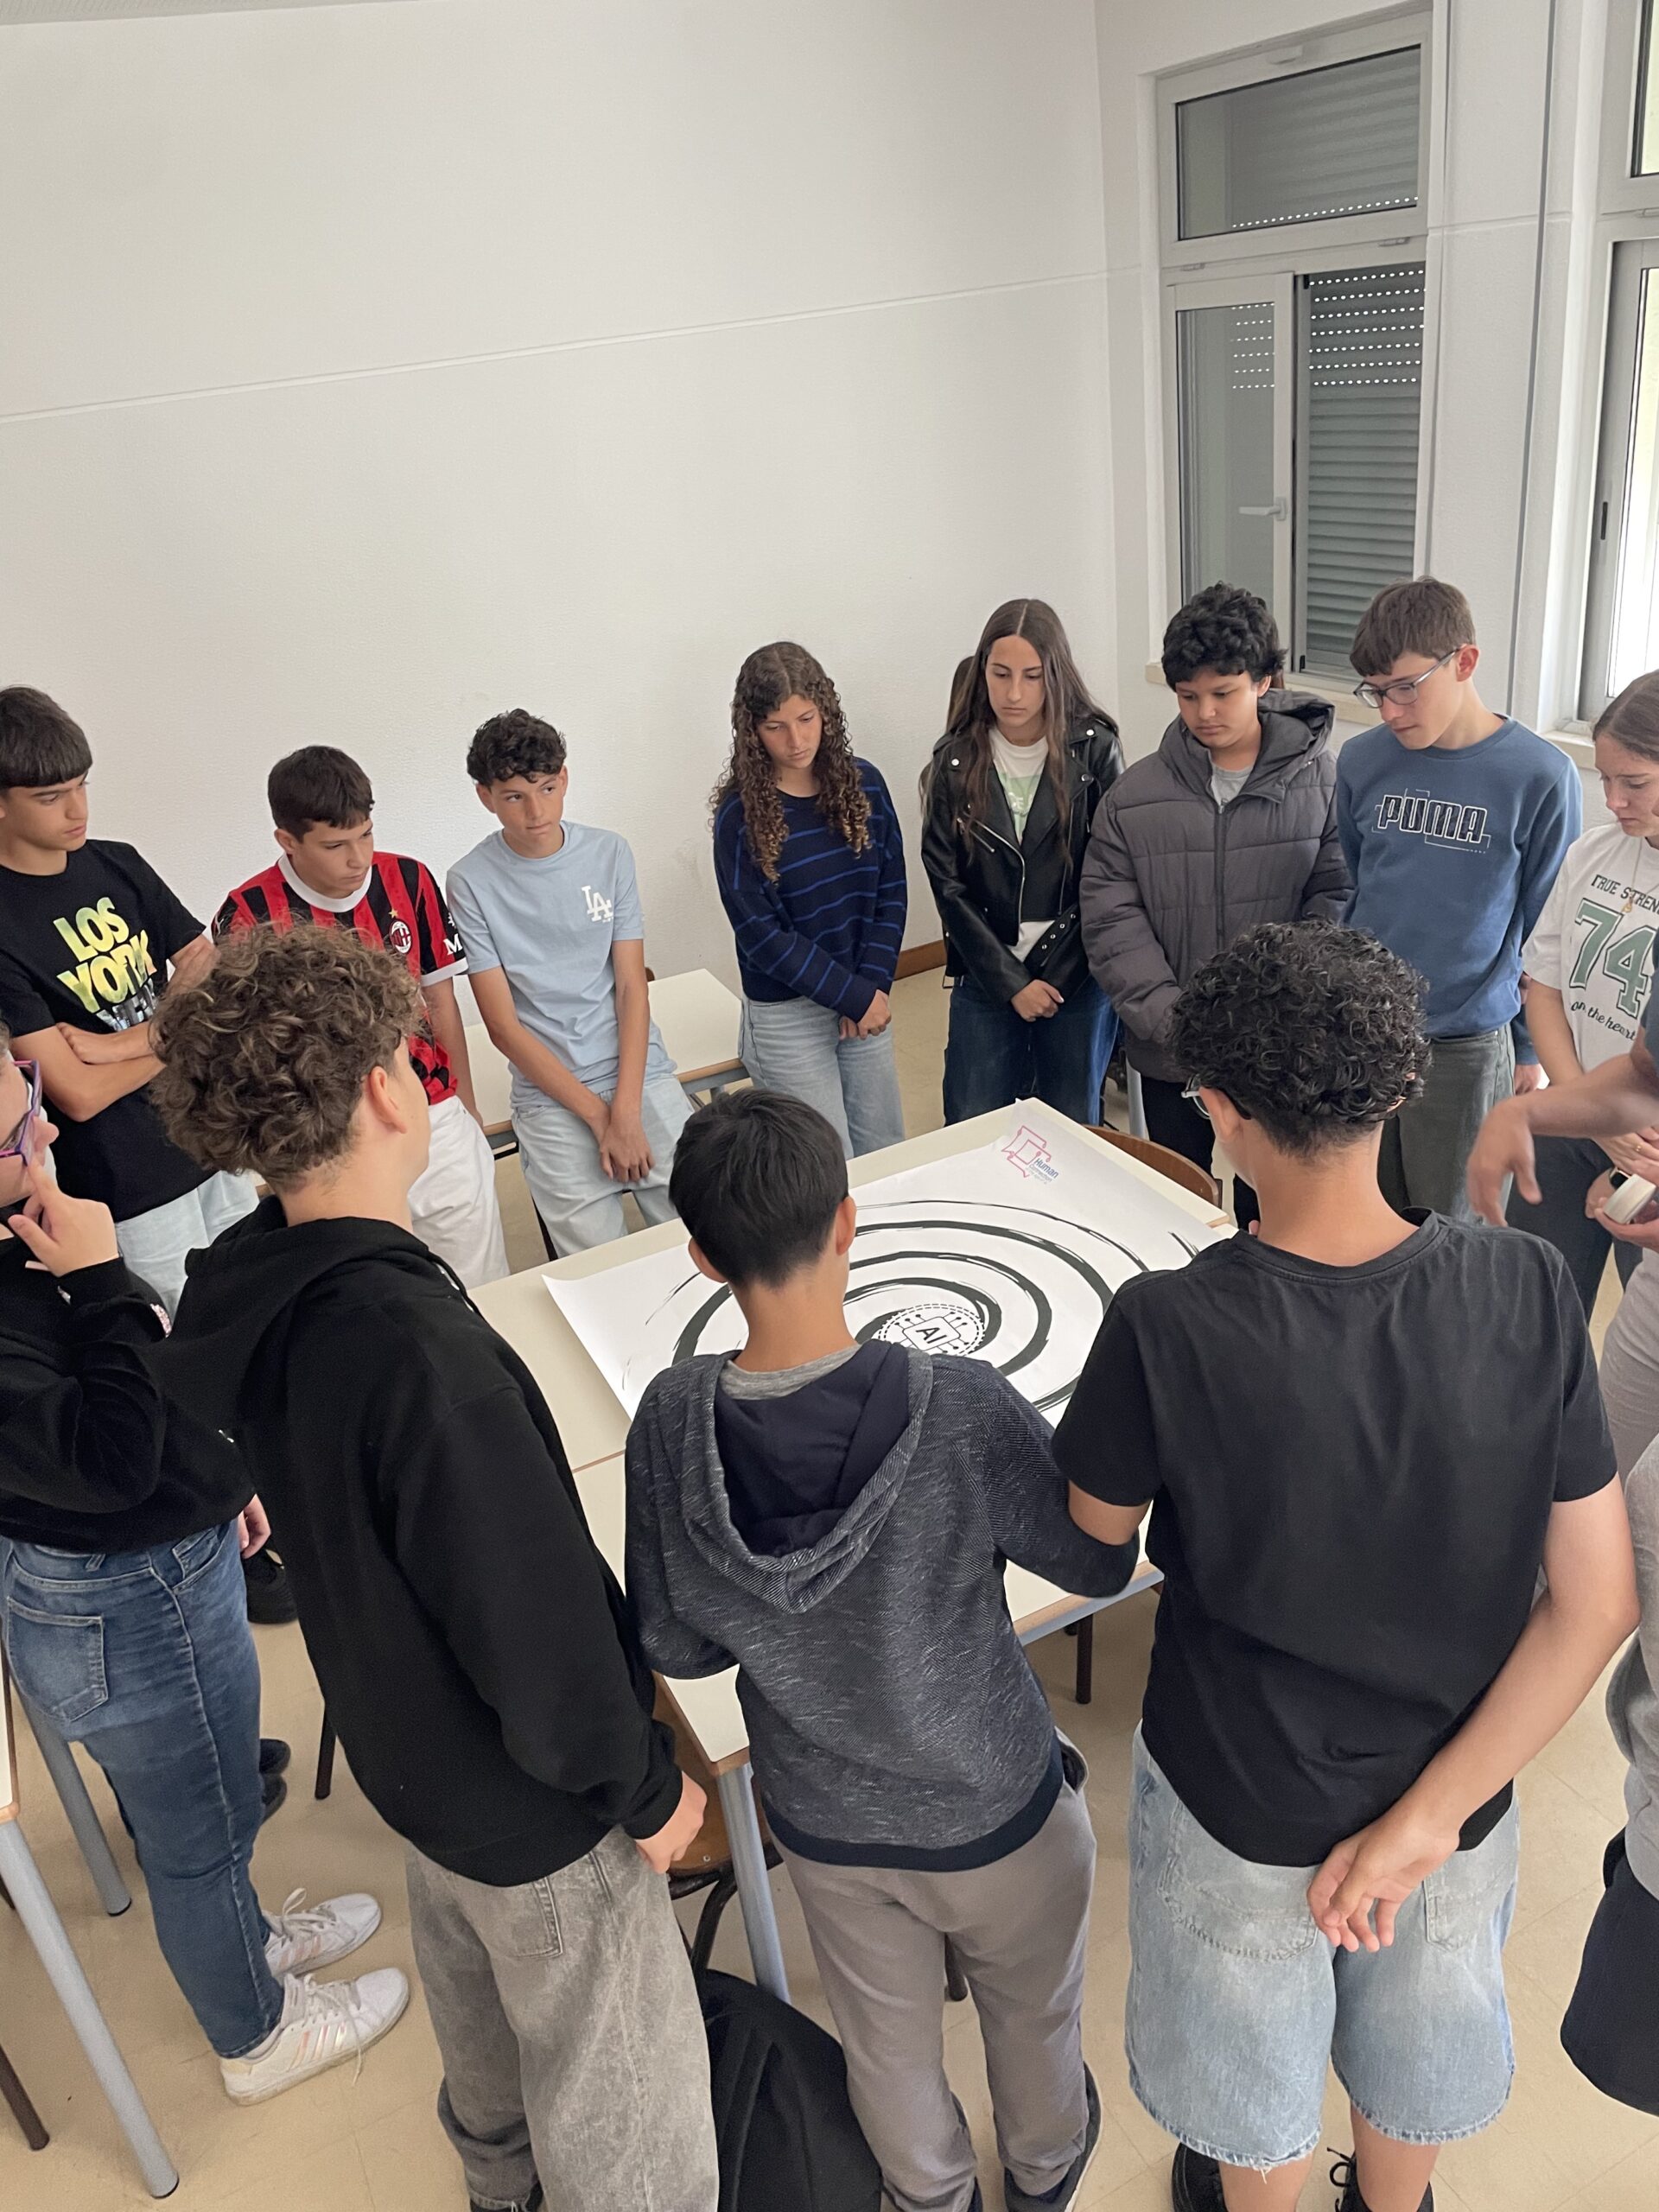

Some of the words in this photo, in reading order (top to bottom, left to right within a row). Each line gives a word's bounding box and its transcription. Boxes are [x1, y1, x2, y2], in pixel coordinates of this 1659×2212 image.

[1377, 794, 1488, 844] PUMA
[581, 885, 613, 922] LA
[1620, 887, 1659, 915] STREN
[53, 896, 130, 963] LOS
[56, 929, 157, 1014] YORK
[1569, 897, 1658, 1020] 74
[1570, 1001, 1586, 1012] on
[1587, 1007, 1605, 1024] the
[1605, 1016, 1636, 1041] heart
[1033, 1158, 1059, 1179] Human
[915, 1327, 948, 1344] AI
